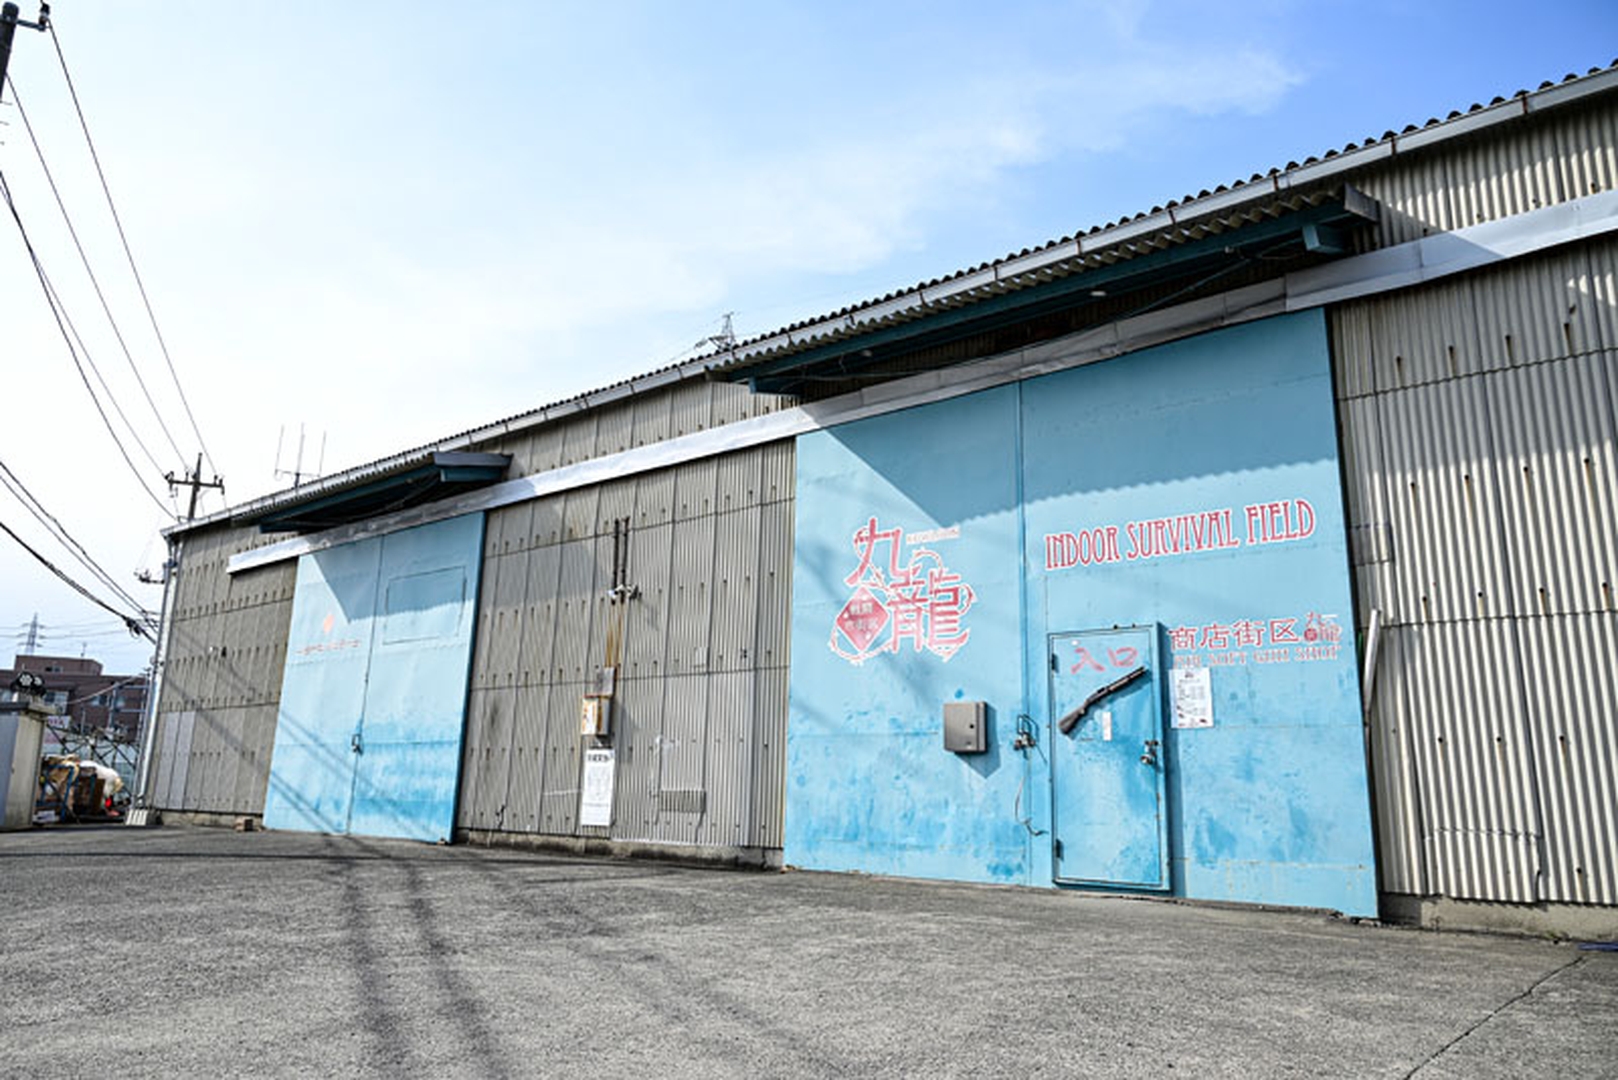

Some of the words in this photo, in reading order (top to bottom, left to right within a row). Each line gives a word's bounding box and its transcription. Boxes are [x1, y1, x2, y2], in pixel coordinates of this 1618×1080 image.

[1045, 525, 1121, 569] INDOOR
[1126, 509, 1239, 560] SURVIVAL
[1245, 499, 1316, 544] FIELD
[1167, 618, 1300, 651] 商店街区
[1070, 647, 1138, 674] 入口
